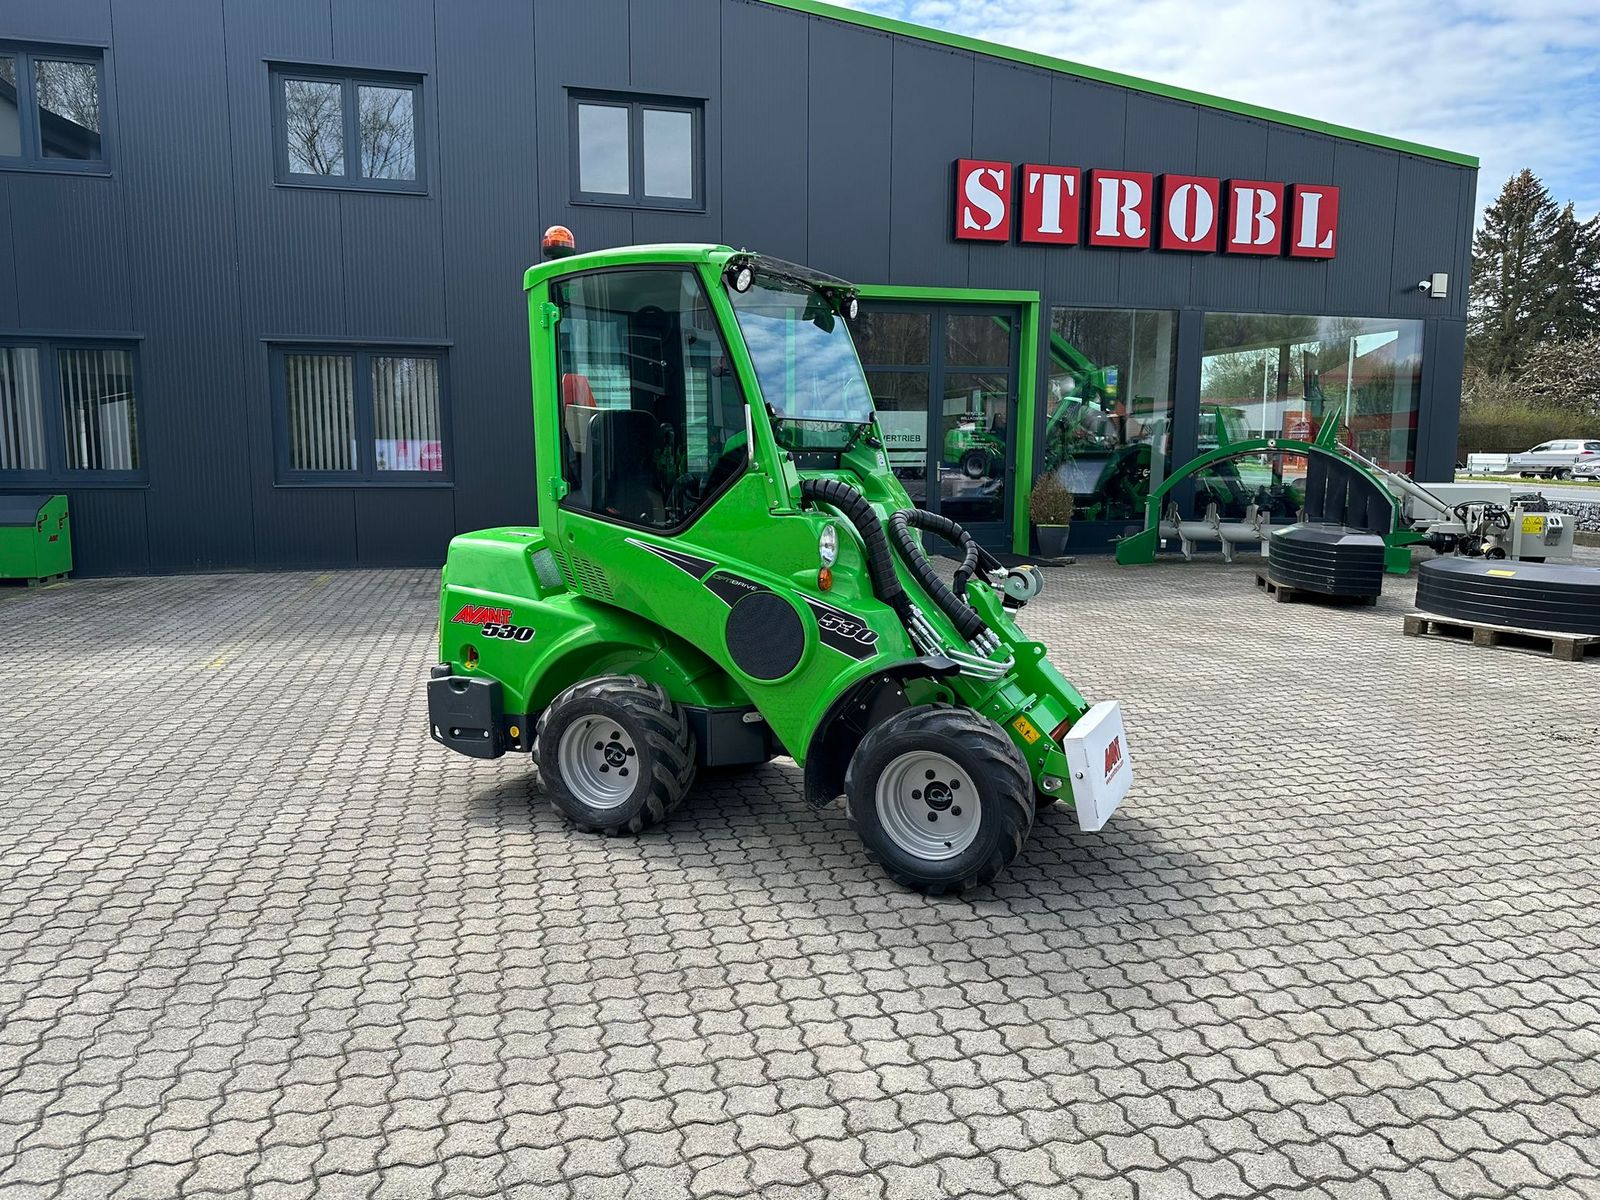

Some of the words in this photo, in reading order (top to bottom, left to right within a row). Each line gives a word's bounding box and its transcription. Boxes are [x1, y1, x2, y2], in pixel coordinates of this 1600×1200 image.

[964, 168, 1332, 248] STROBL
[450, 604, 512, 625] AVANT
[480, 623, 536, 642] 530
[817, 612, 880, 645] 530
